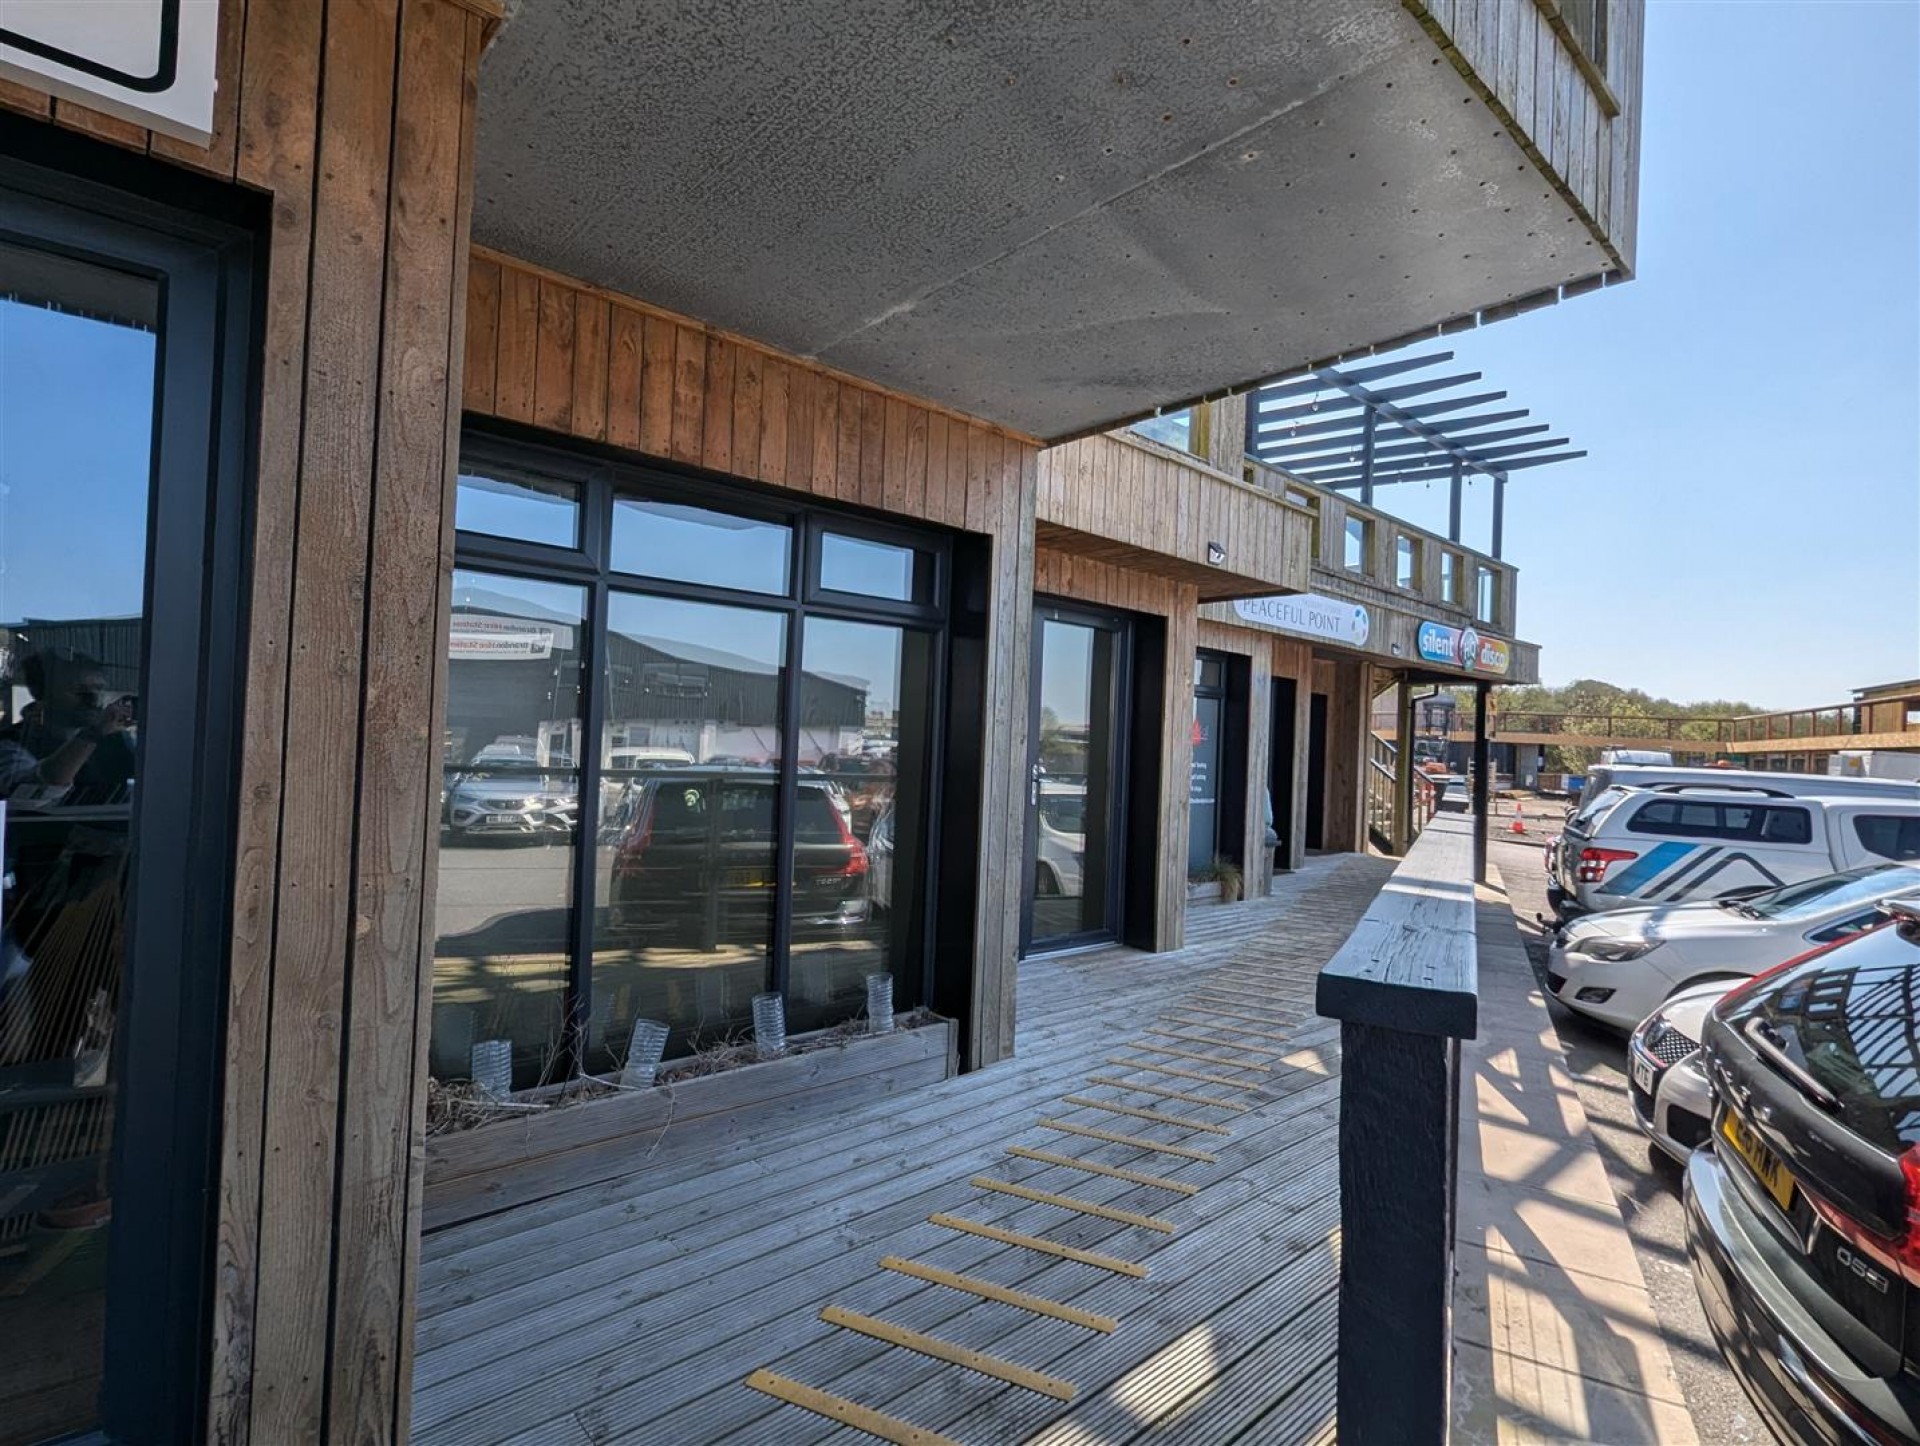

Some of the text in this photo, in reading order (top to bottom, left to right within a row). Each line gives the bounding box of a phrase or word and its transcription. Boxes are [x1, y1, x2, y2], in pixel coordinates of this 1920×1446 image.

[1243, 599, 1305, 625] PEACEFUL
[1308, 611, 1341, 633] POINT
[1422, 628, 1506, 666] silent HQ disco
